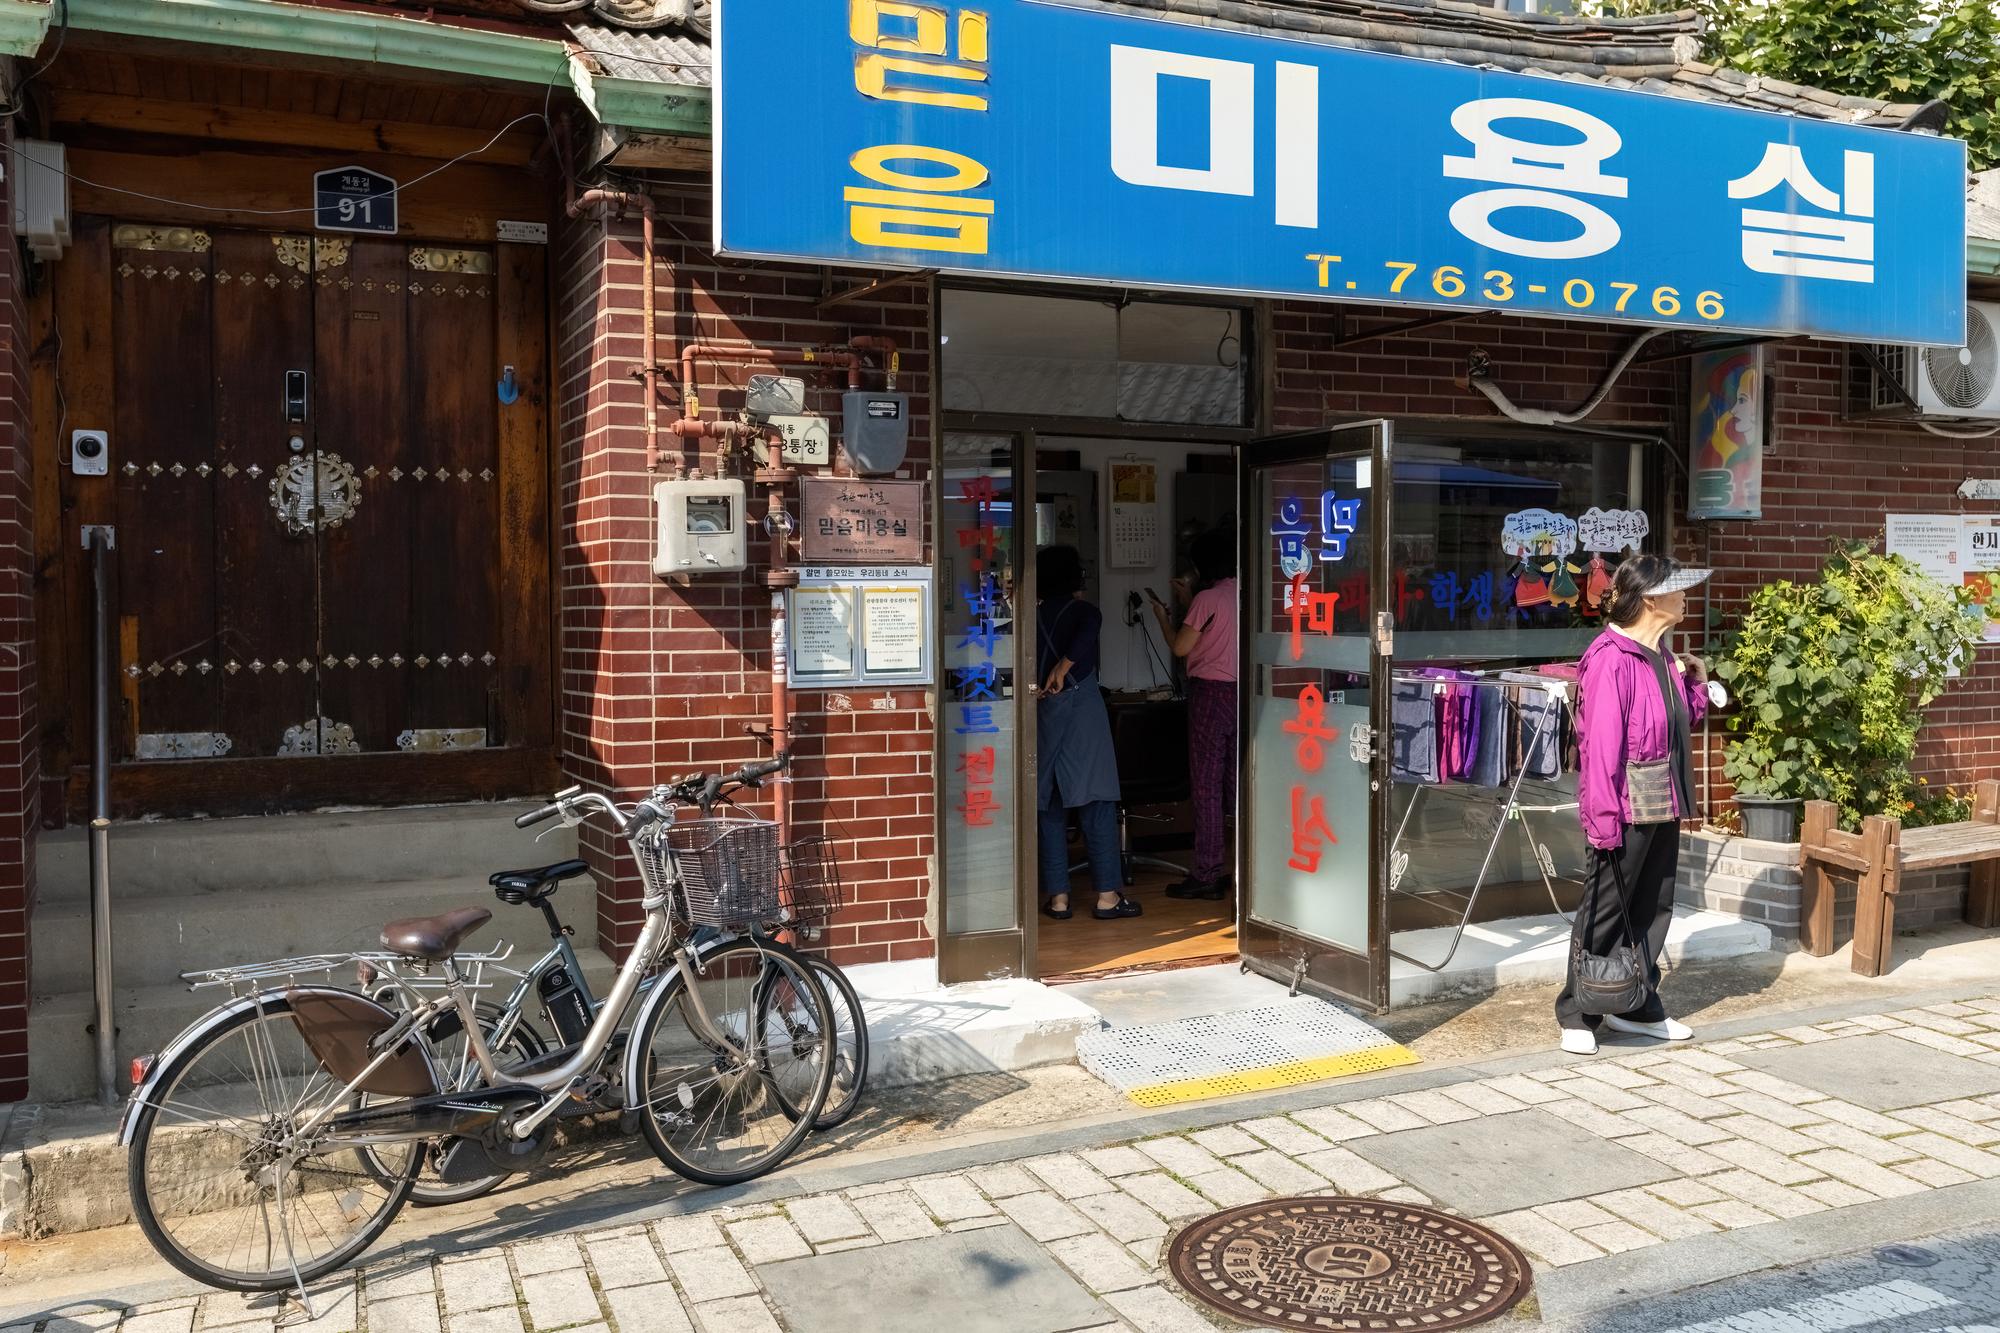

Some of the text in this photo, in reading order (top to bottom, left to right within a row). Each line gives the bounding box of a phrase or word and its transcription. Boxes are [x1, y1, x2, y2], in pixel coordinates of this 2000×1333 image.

[843, 0, 995, 254] 믿음
[1110, 44, 1875, 284] 미용실
[341, 175, 370, 187] 계동길
[338, 198, 371, 223] 91
[1305, 253, 1726, 320] T. 763-0766
[818, 517, 907, 537] 믿음미용실
[805, 568, 821, 577] 알면
[860, 568, 889, 577] 우리동네
[893, 568, 908, 577] 소식
[955, 746, 1003, 826] 전문
[1323, 1246, 1371, 1276] SK
